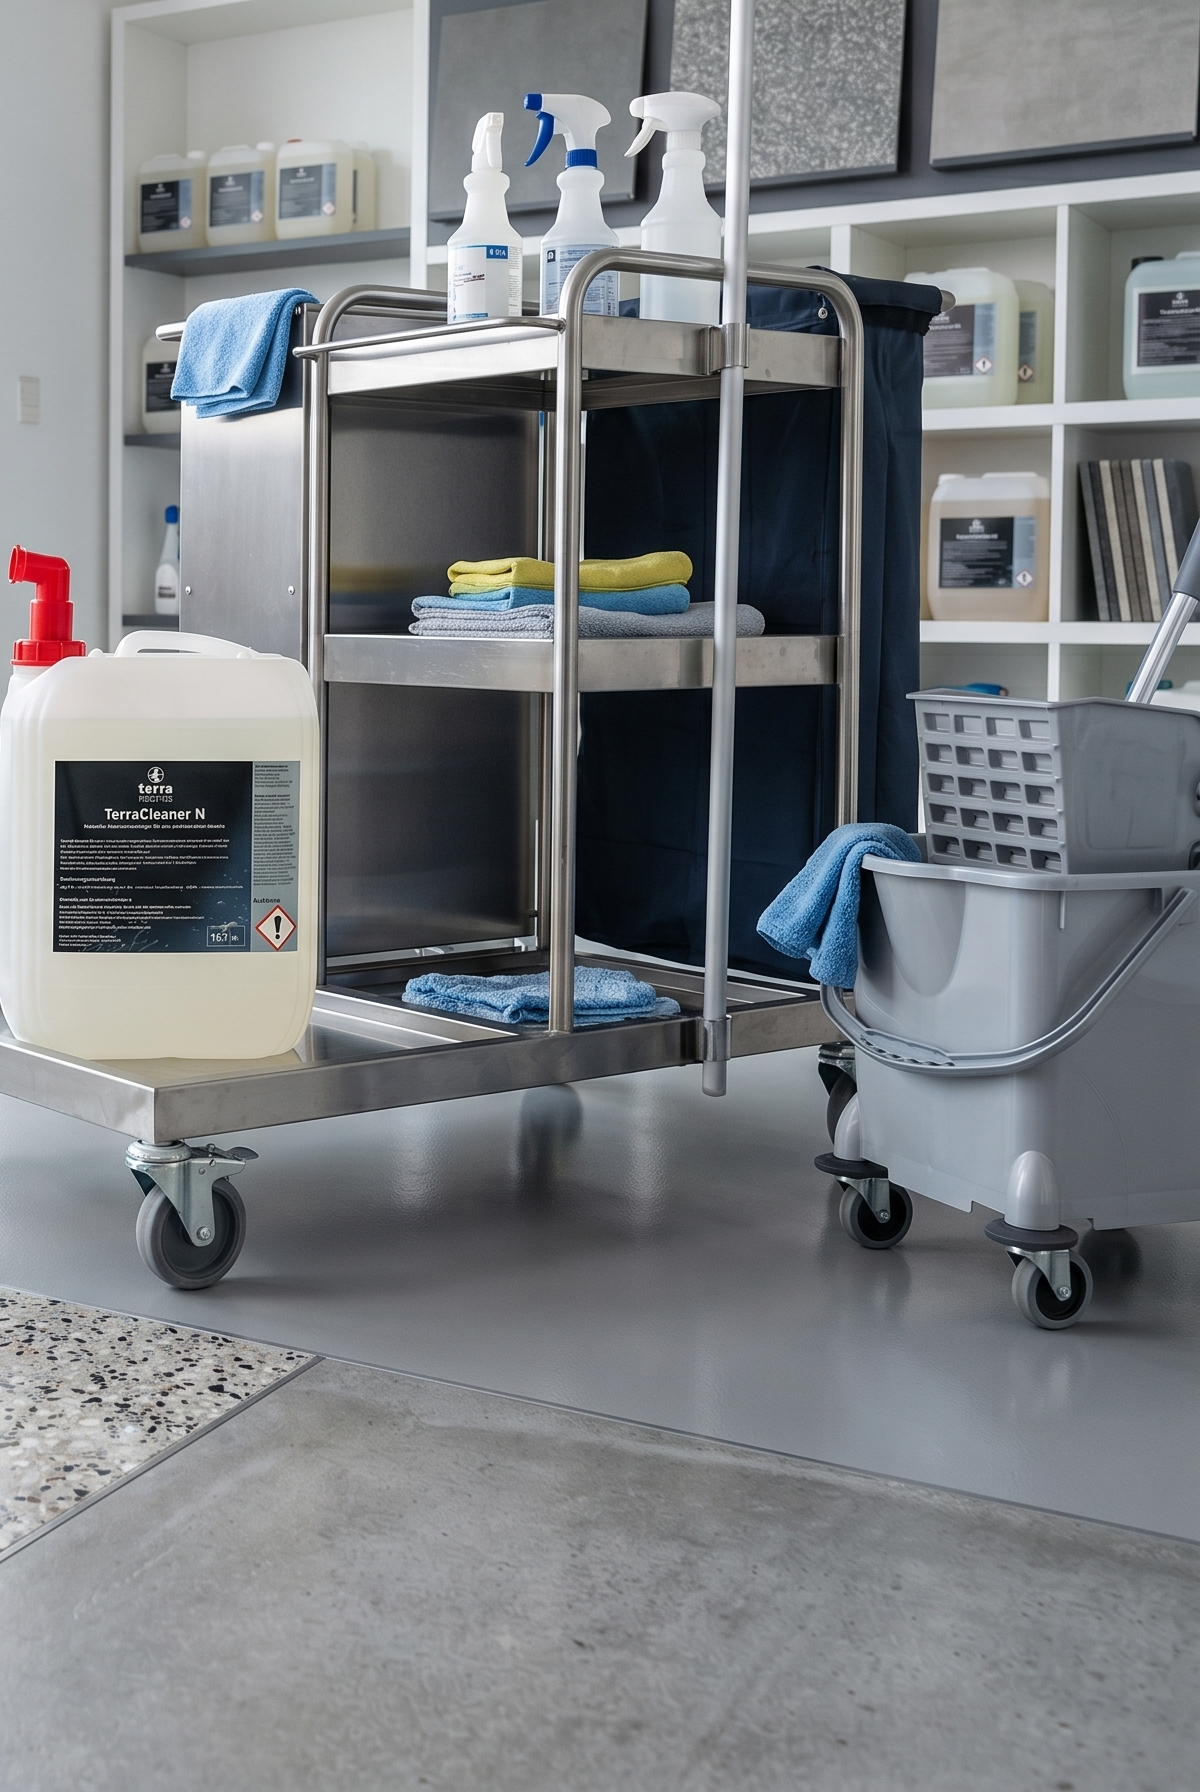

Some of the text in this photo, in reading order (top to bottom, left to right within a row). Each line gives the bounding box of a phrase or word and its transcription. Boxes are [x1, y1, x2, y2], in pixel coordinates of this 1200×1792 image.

[138, 783, 173, 794] terra
[104, 808, 205, 820] TerraCleaner N
